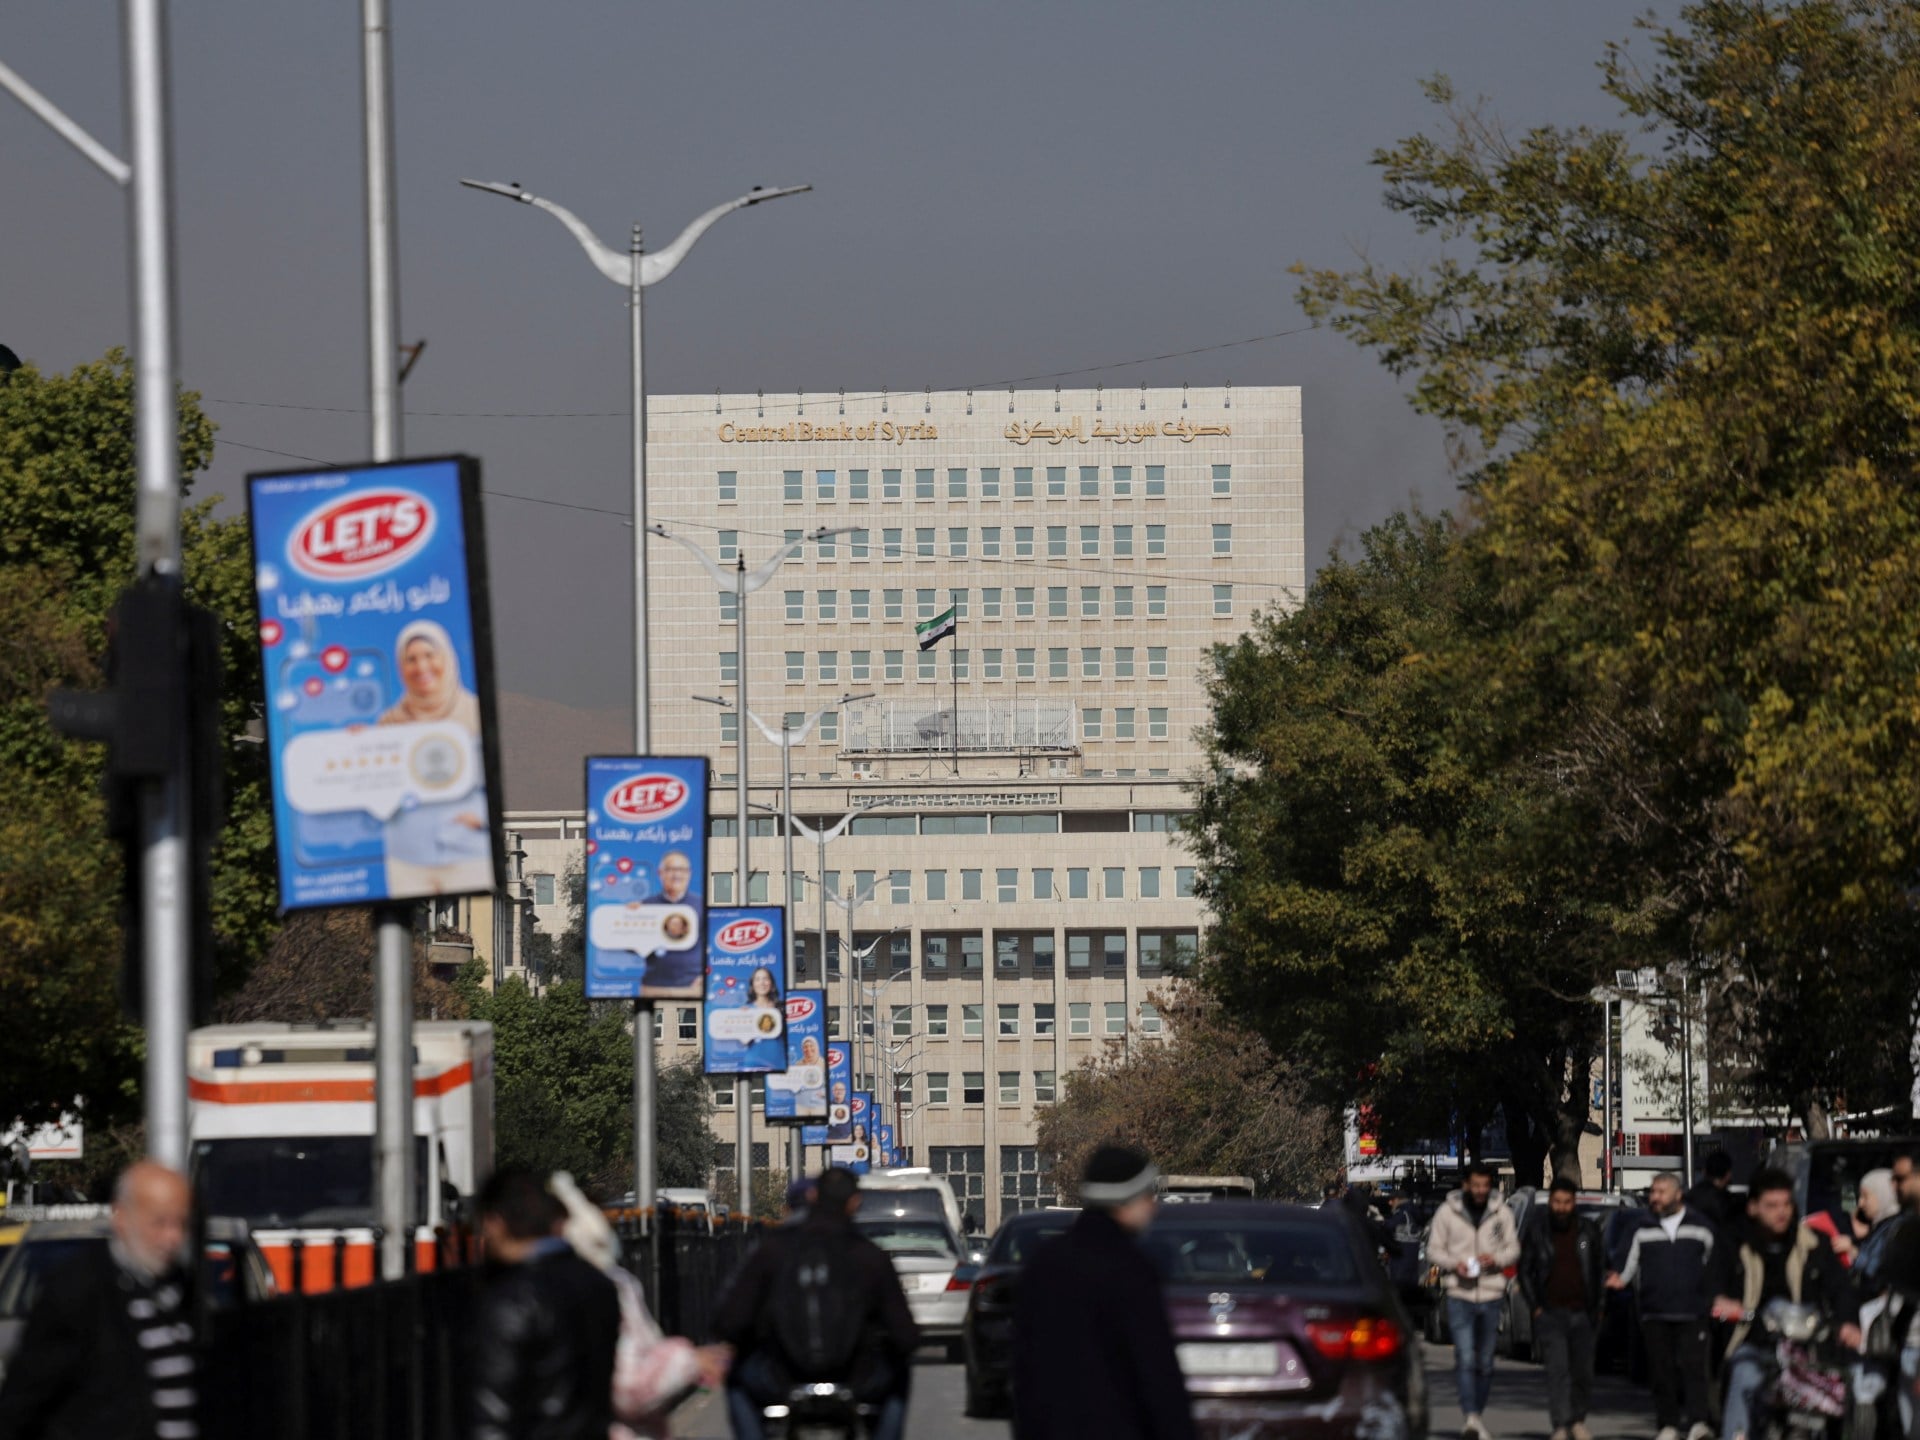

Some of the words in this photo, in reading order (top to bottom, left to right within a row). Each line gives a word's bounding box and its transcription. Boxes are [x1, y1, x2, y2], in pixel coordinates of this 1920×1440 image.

[719, 421, 794, 442] Central
[798, 422, 853, 441] Bank
[853, 421, 877, 440] of
[881, 421, 938, 445] Syria
[1004, 416, 1090, 445] المركزي
[1091, 419, 1156, 444] سورية
[1161, 417, 1231, 442] مصرف
[309, 500, 419, 553] LET'S
[618, 781, 680, 806] LET'S
[723, 923, 766, 943] LET'S
[786, 1000, 811, 1014] ET'S
